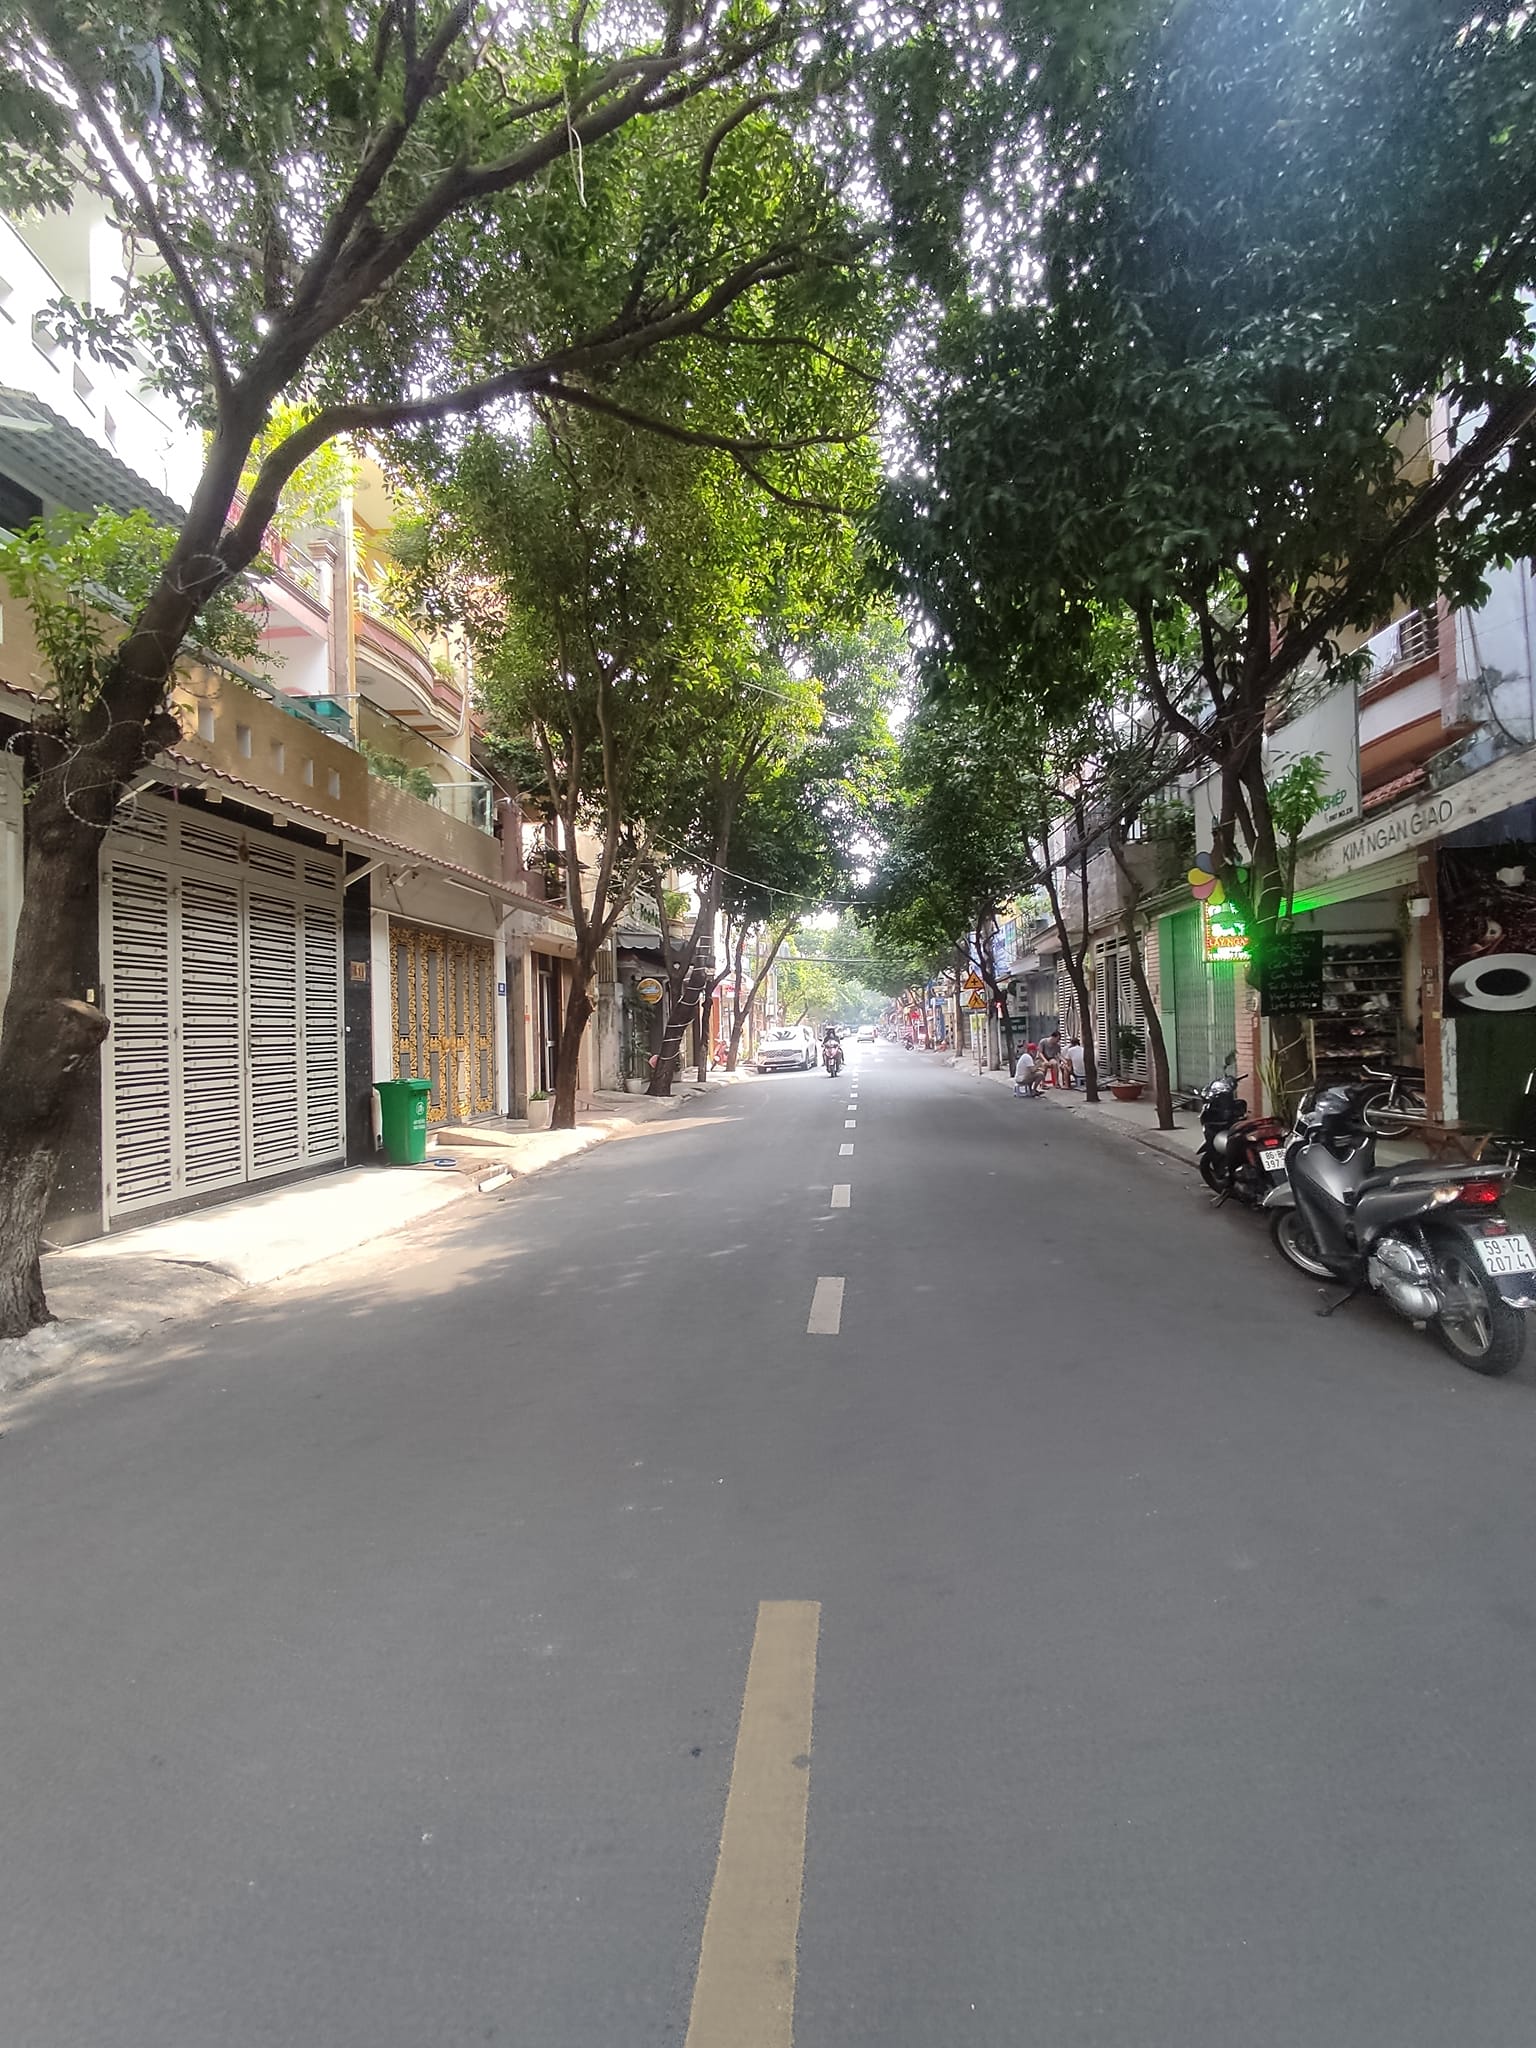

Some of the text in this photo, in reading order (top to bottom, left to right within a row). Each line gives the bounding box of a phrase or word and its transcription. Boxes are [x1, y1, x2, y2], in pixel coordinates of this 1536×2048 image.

[1341, 837, 1365, 865] KIM
[1410, 799, 1453, 835] GIAO
[1483, 1237, 1524, 1255] 59-T2
[1486, 1253, 1535, 1273] 207.41
